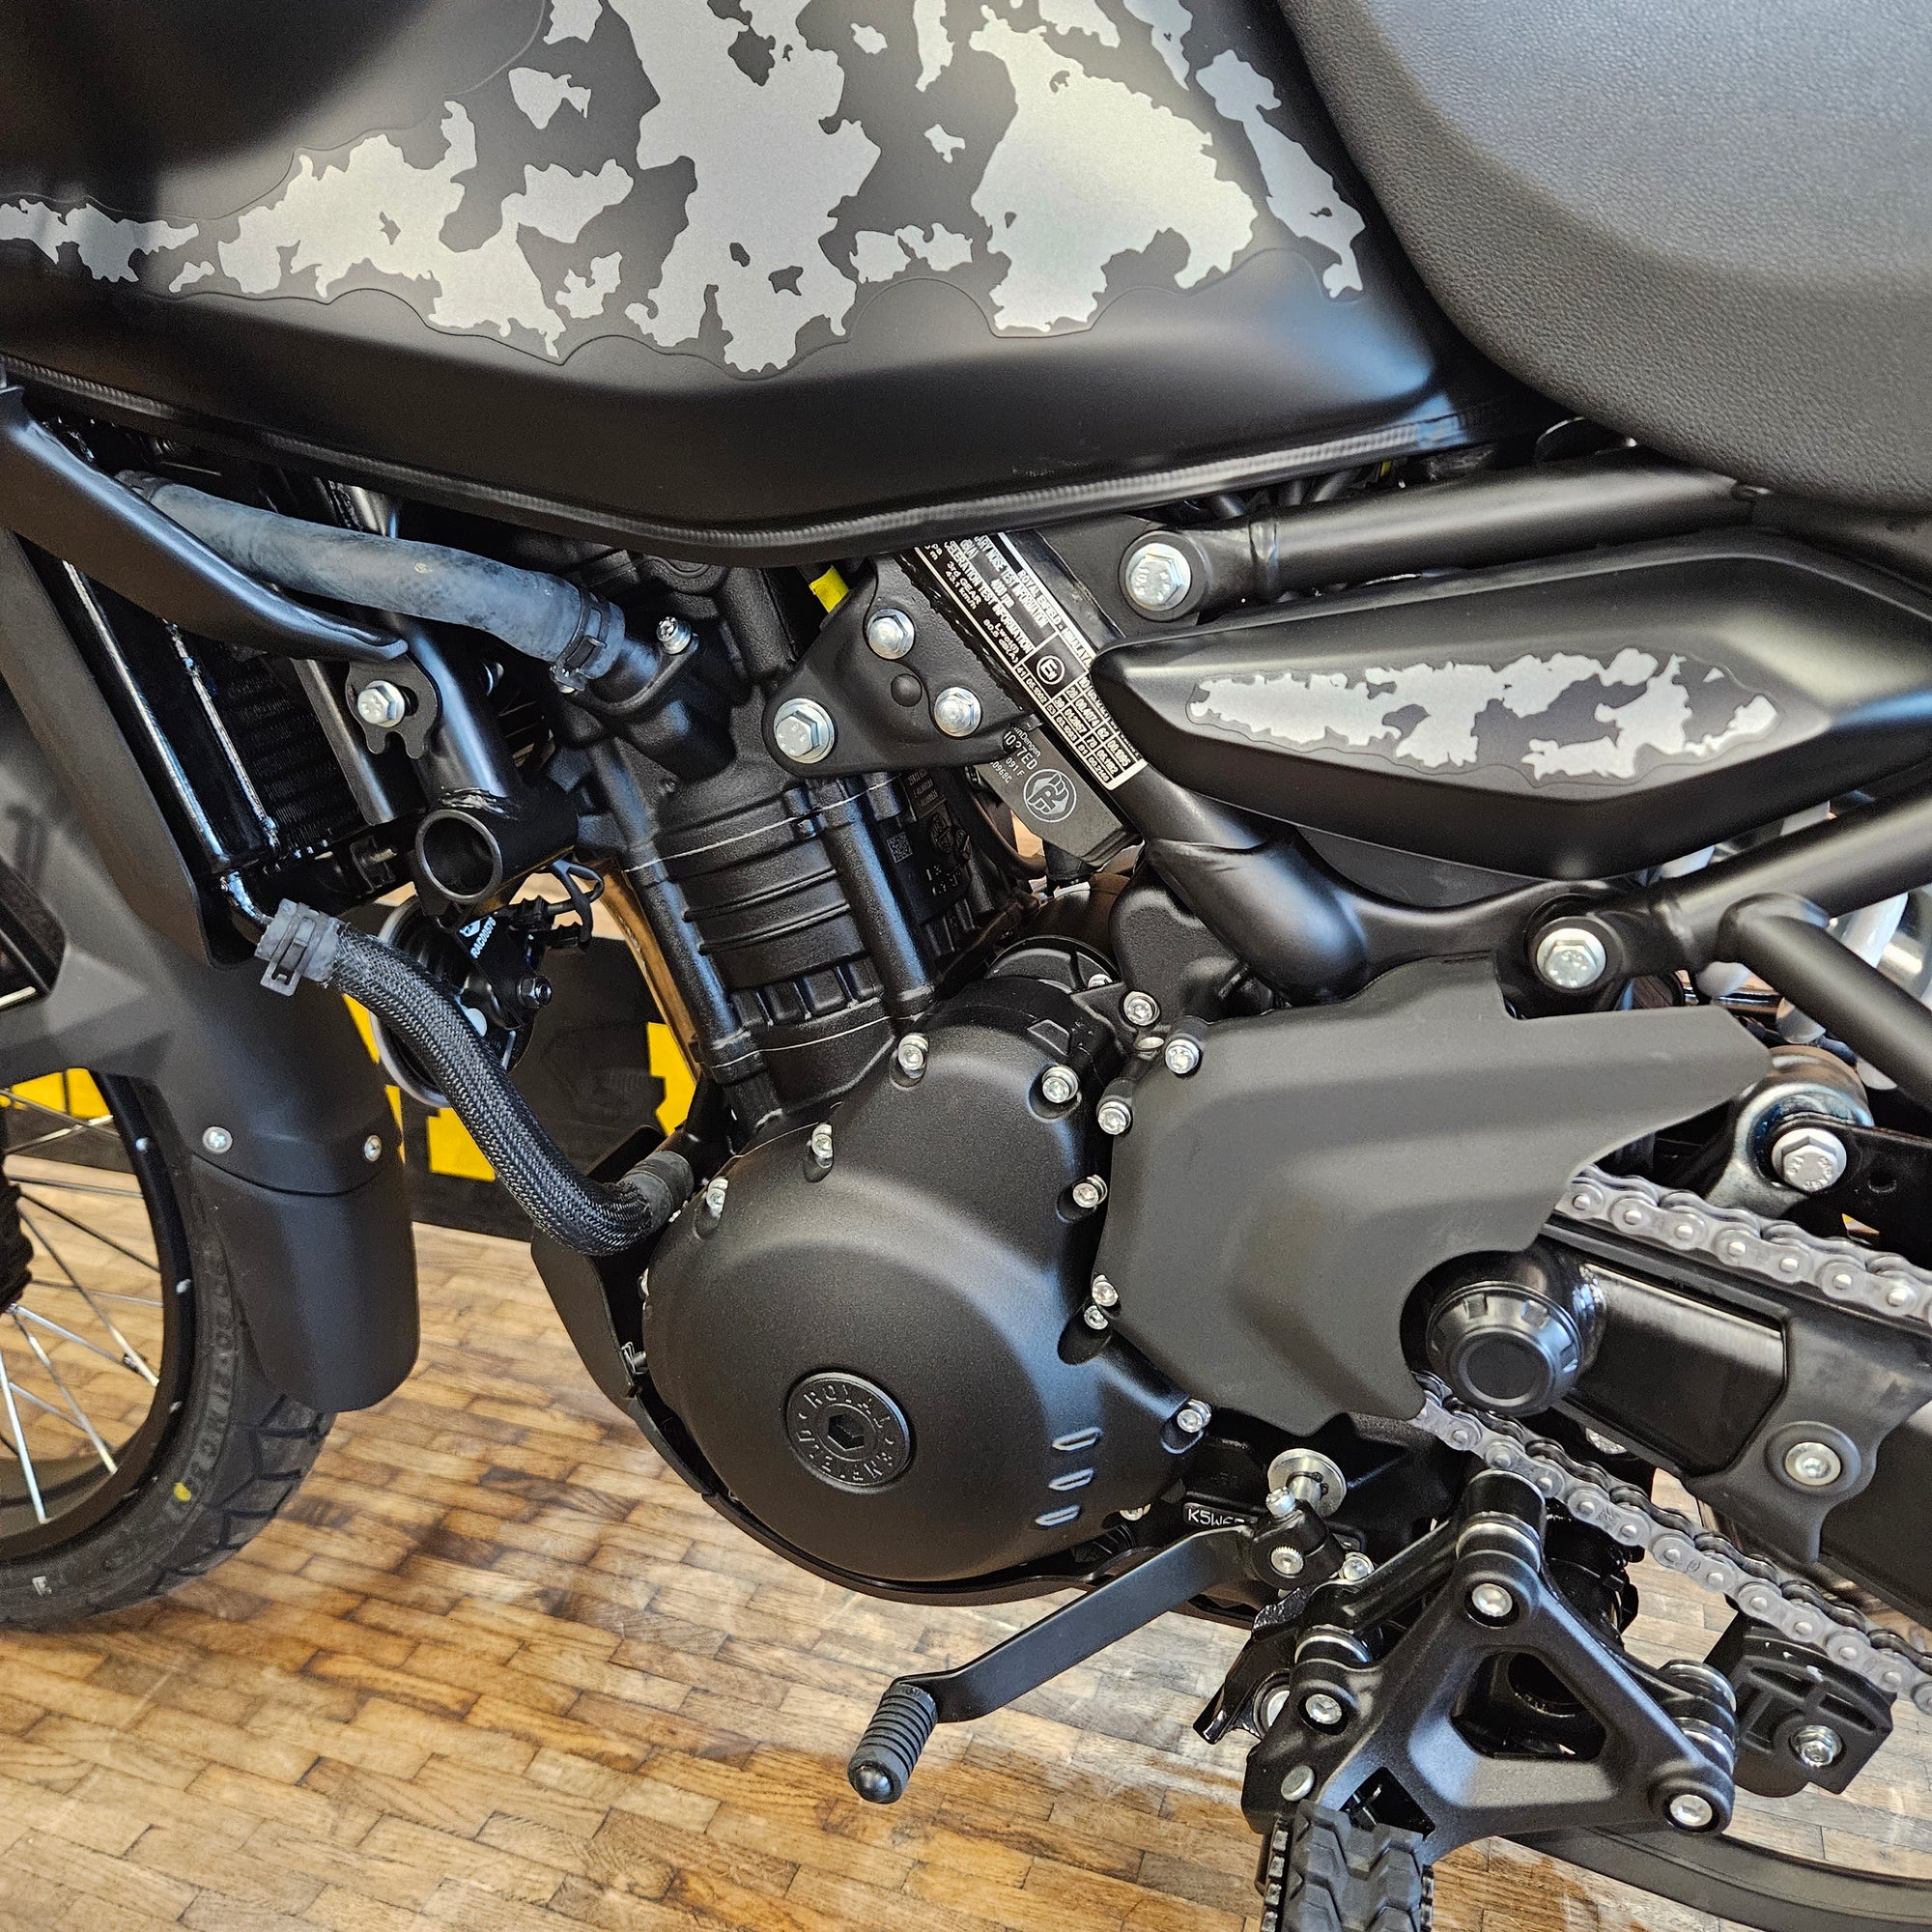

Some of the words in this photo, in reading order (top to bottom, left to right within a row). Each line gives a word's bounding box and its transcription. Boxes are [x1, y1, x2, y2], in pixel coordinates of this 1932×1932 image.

[947, 560, 960, 577] 3rd
[959, 577, 981, 604] GEAR
[974, 535, 992, 552] ARY
[985, 549, 1006, 570] NOISE
[999, 567, 1017, 586] TEST
[1011, 584, 1048, 627] INFORMATION
[989, 577, 1007, 595] 4000
[1017, 570, 1039, 596] ROYAL
[1037, 595, 1061, 624] ENFIELD
[945, 570, 959, 587] 43.1
[958, 587, 977, 609] km/h
[998, 638, 1018, 663] dB(A)
[977, 583, 996, 605] TEST
[992, 603, 1033, 652] INFORMATION
[1015, 666, 1026, 676] 41
[1026, 678, 1046, 702] 05.1002
[1078, 677, 1090, 688] 10
[1074, 697, 1099, 726] 00.4074
[1096, 726, 1109, 739] 62
[1107, 740, 1130, 766] 00.1095
[1087, 736, 1097, 748] 78
[1006, 757, 1018, 771] 091
[1016, 769, 1025, 778] F
